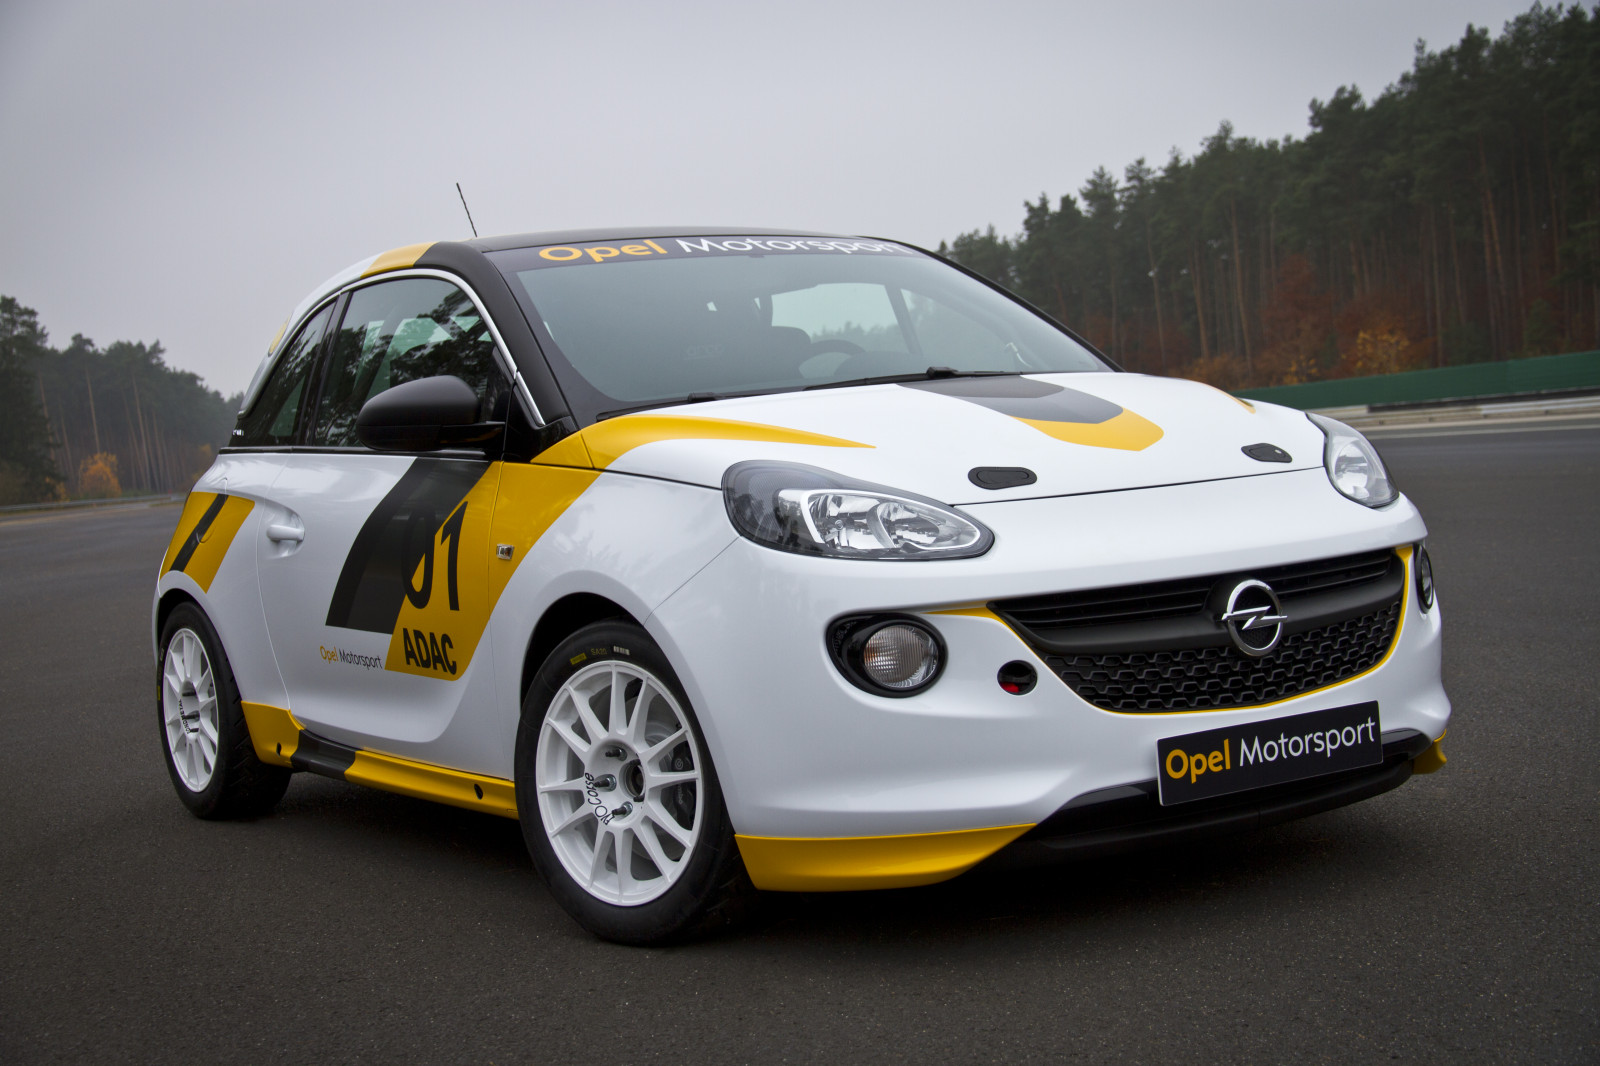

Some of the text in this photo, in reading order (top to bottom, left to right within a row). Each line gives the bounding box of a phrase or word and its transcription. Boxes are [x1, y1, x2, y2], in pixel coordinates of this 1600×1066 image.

[539, 237, 913, 262] Opel Motorsport
[402, 501, 468, 611] 01
[319, 645, 382, 670] Opel Motorsport
[402, 627, 457, 675] ADAC
[1165, 716, 1376, 784] Opel Motorsport
